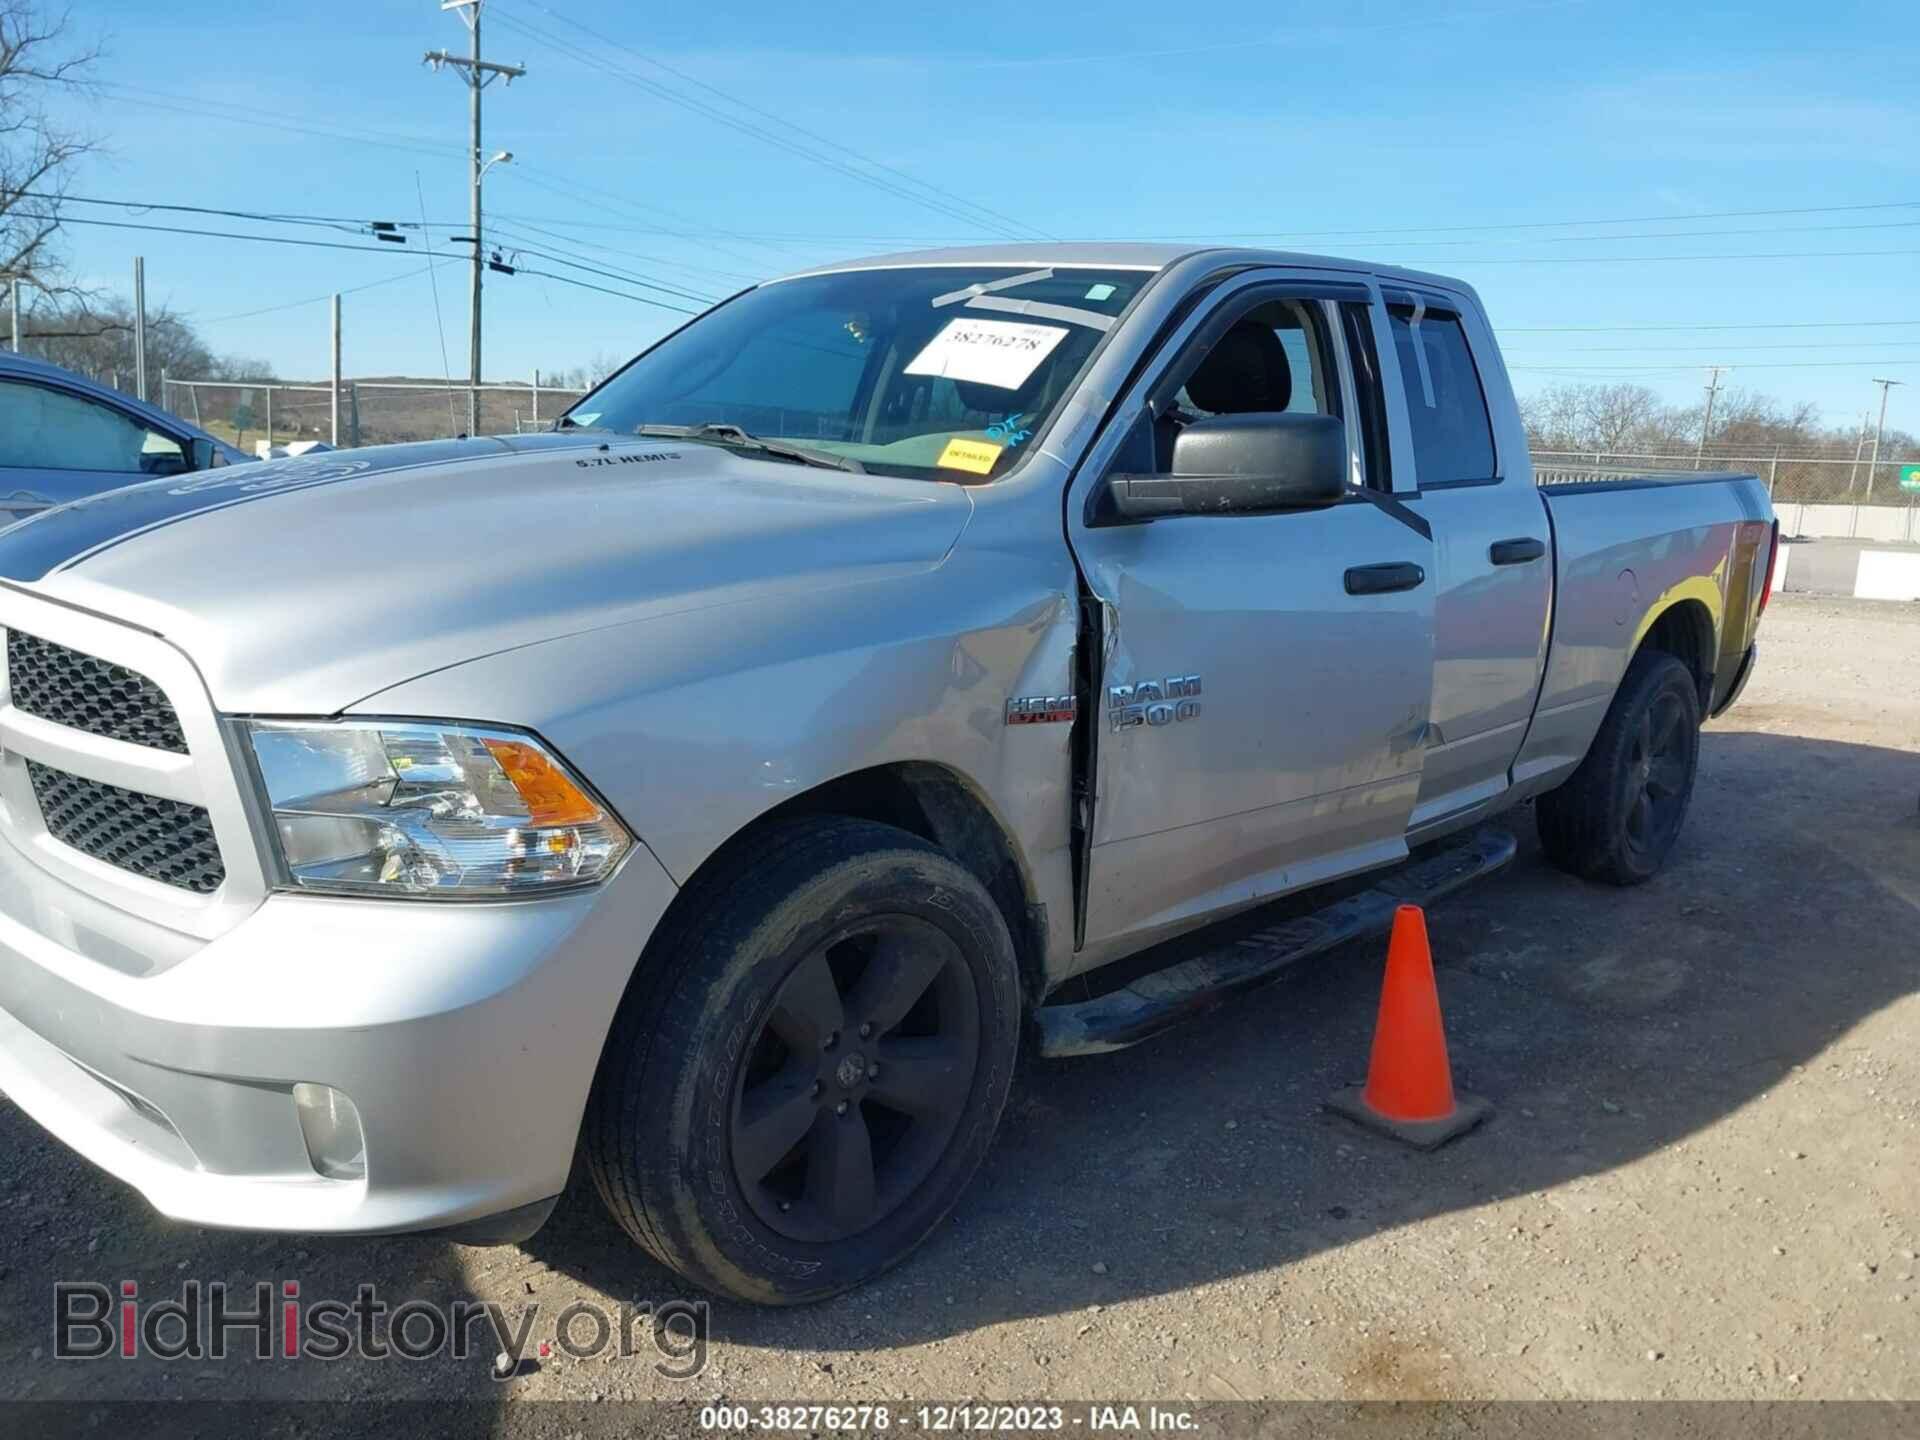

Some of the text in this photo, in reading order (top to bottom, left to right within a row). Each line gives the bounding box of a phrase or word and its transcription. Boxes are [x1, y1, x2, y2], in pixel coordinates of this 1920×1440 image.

[945, 331, 1041, 352] 38276278
[575, 452, 667, 468] 5.7L HEMI
[1107, 674, 1202, 708] RAM
[1006, 695, 1077, 712] HEMI
[1108, 699, 1201, 734] 1500
